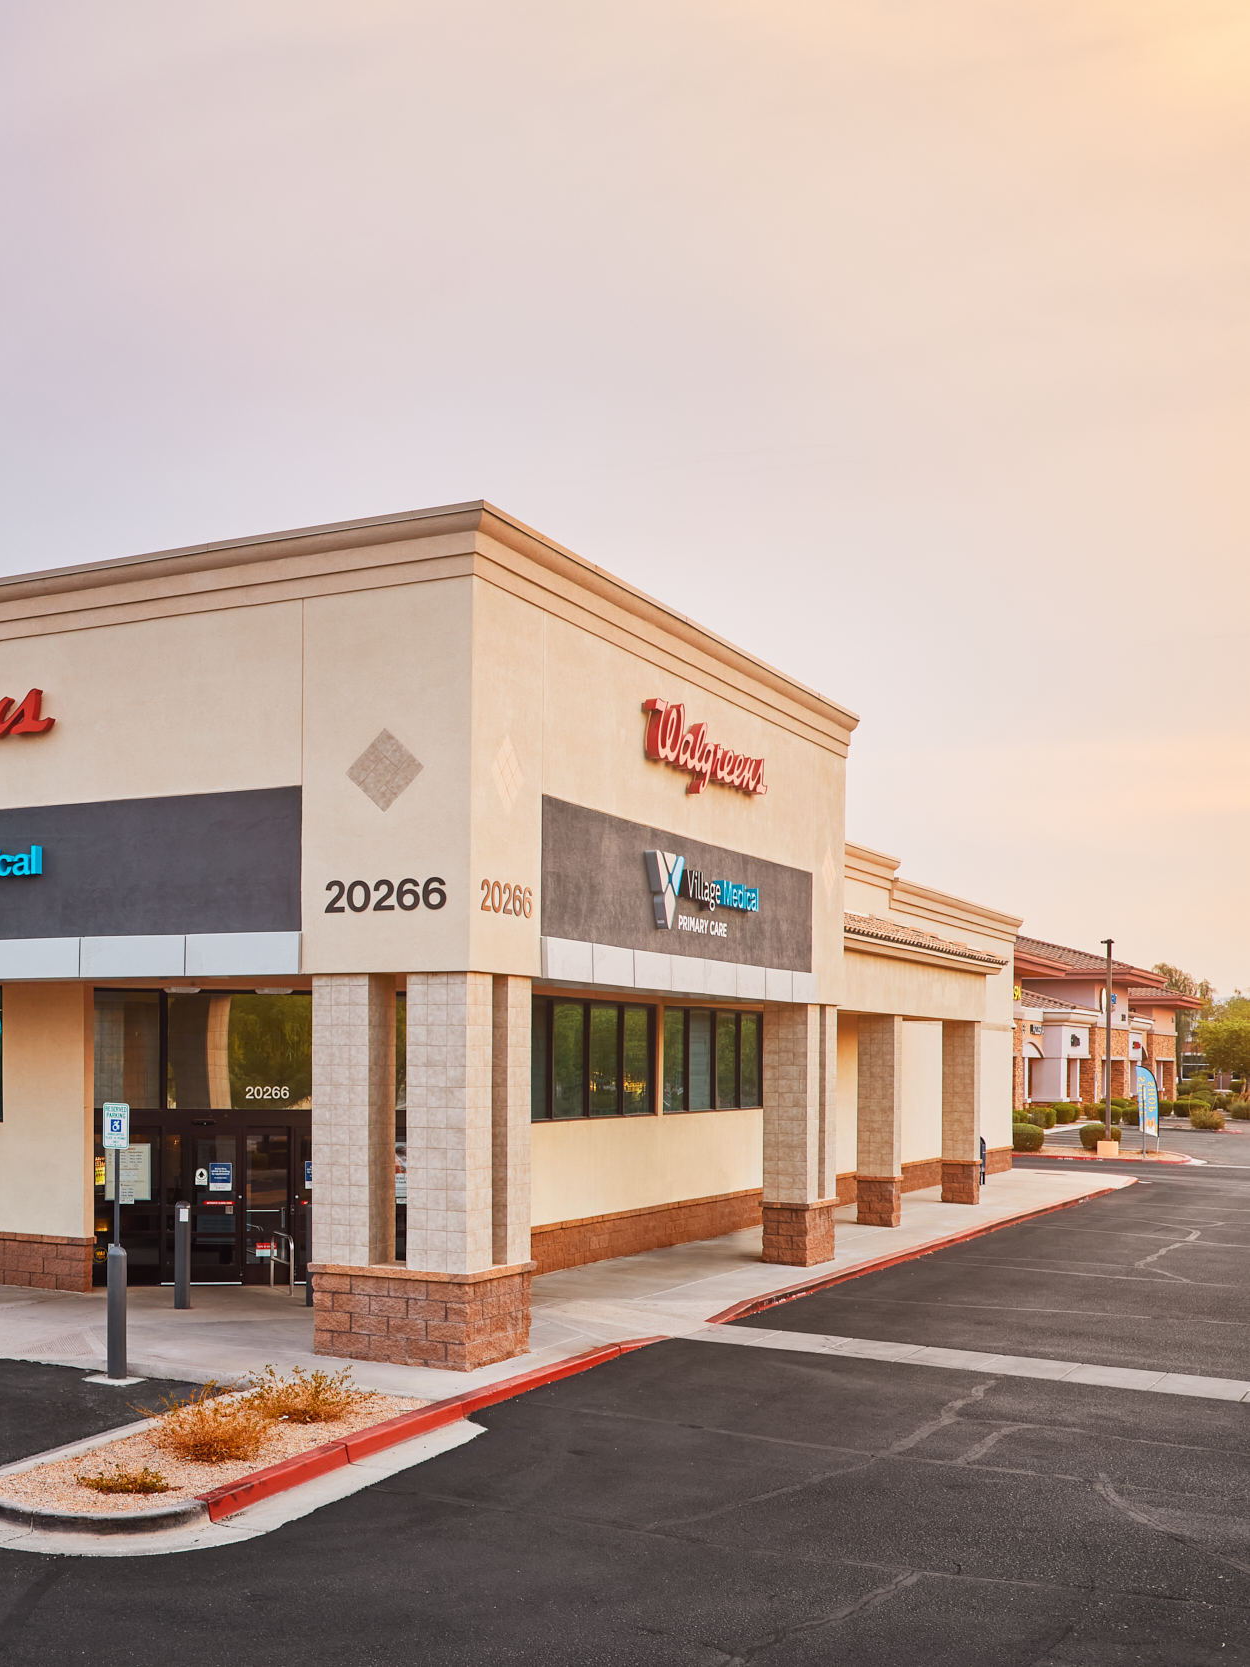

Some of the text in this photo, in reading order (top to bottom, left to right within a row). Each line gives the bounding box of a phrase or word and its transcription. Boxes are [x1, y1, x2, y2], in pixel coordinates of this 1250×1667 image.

[644, 698, 767, 795] Walgreens
[324, 877, 447, 914] 20266
[480, 878, 533, 919] 20266
[686, 869, 759, 912] Village Medical
[678, 914, 727, 938] PRIMARY CARE
[245, 1086, 290, 1099] 20266
